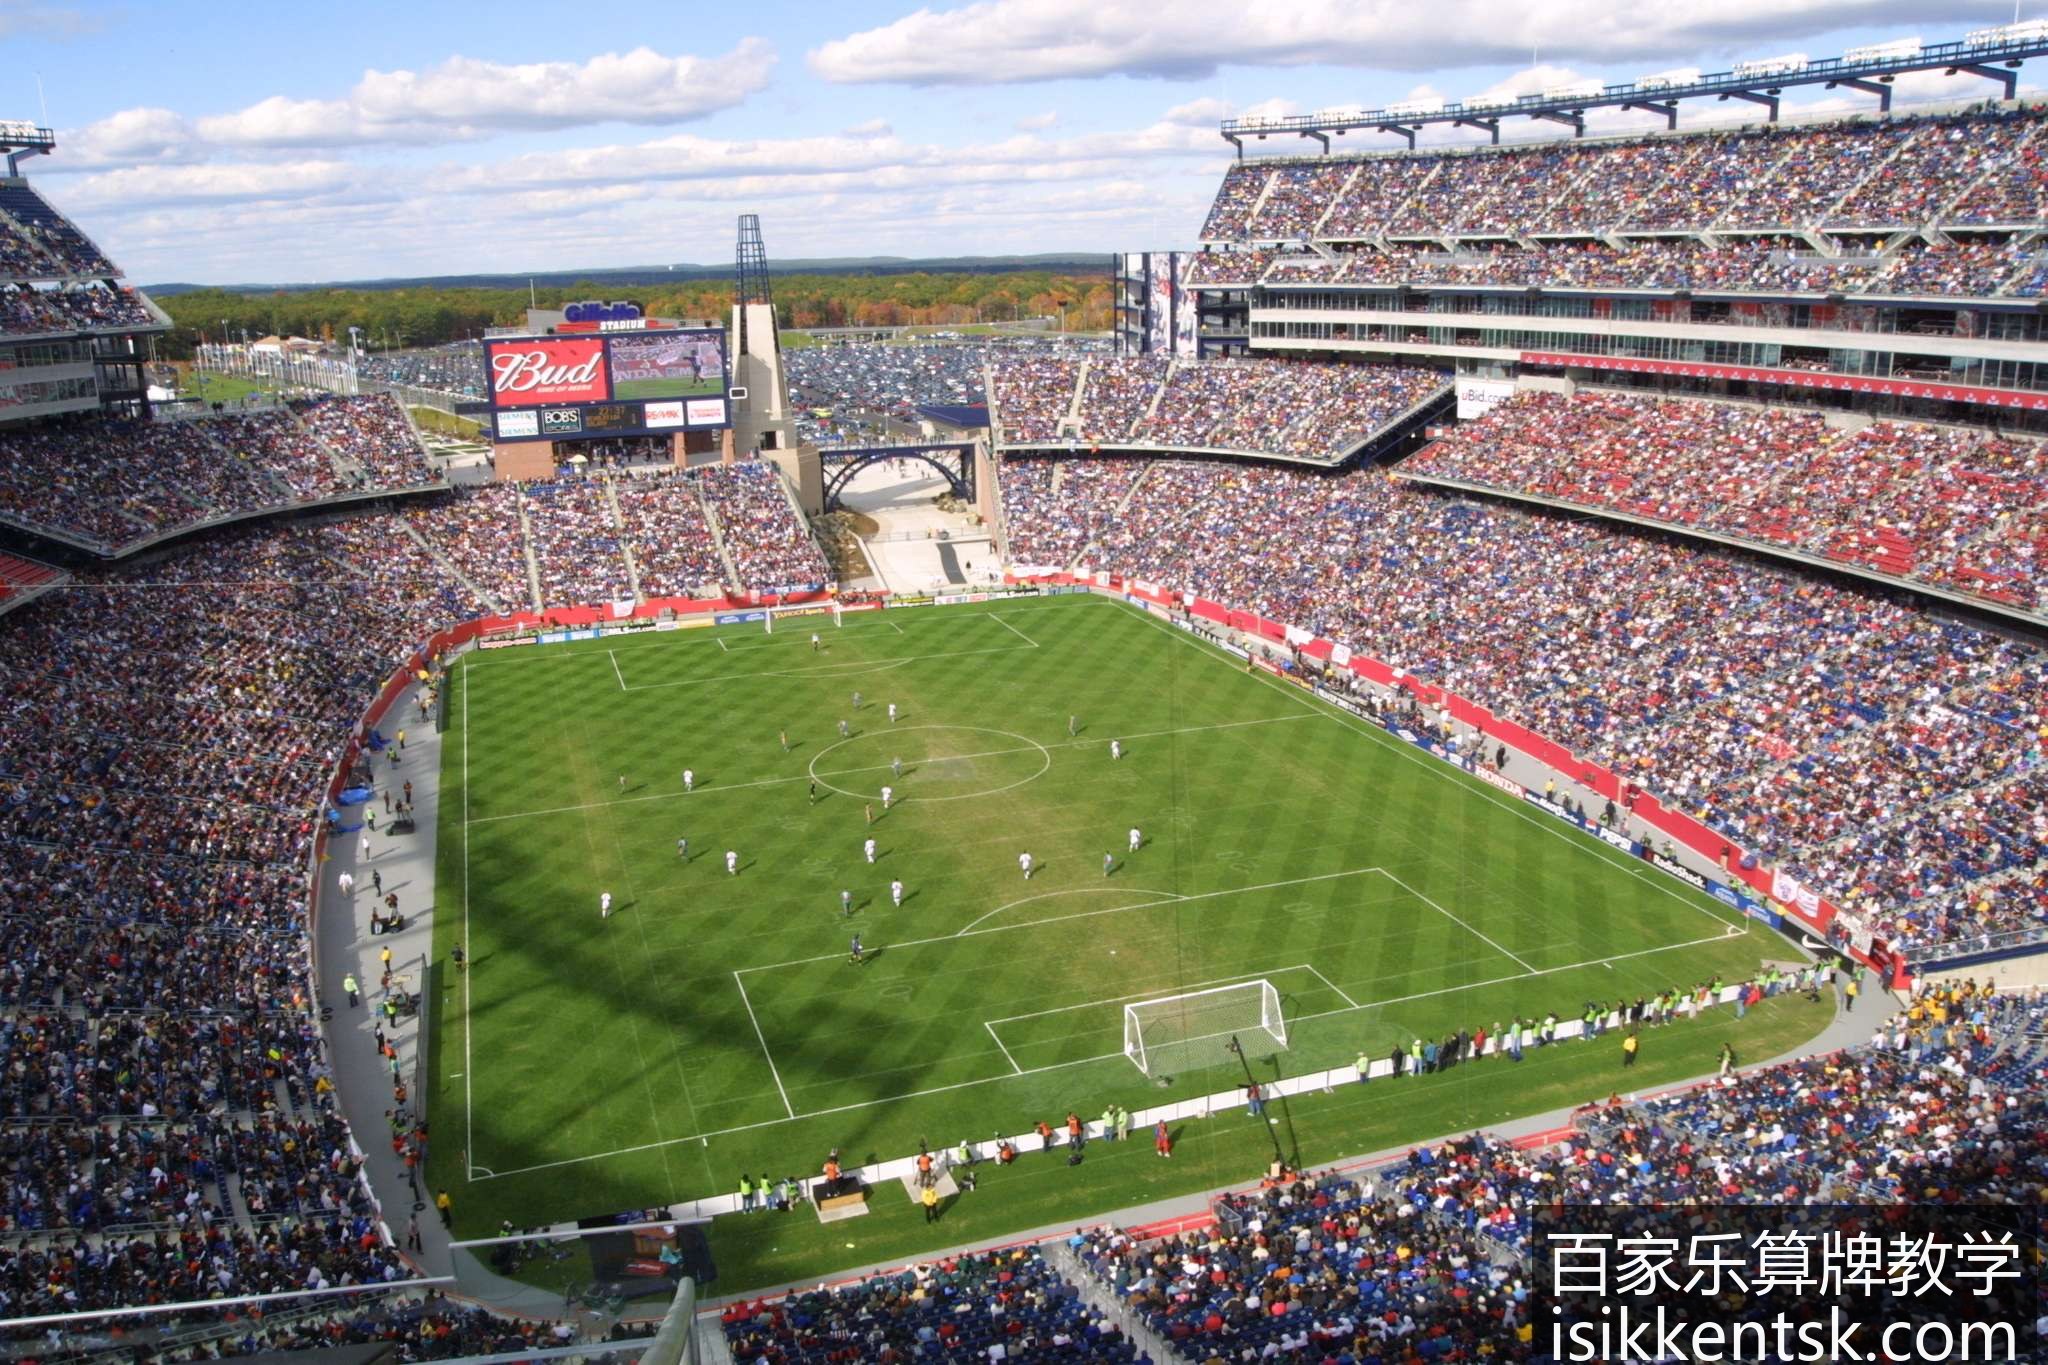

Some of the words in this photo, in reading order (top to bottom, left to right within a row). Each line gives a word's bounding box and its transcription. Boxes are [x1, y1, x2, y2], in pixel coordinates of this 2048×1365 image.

[564, 302, 640, 322] Gillette
[600, 320, 646, 331] STADIUM
[492, 351, 603, 393] Bud
[544, 410, 578, 424] BOB'S
[499, 426, 538, 437] SIEMENS
[1475, 764, 1524, 799] HONDA
[1599, 827, 1632, 851] PEPSI
